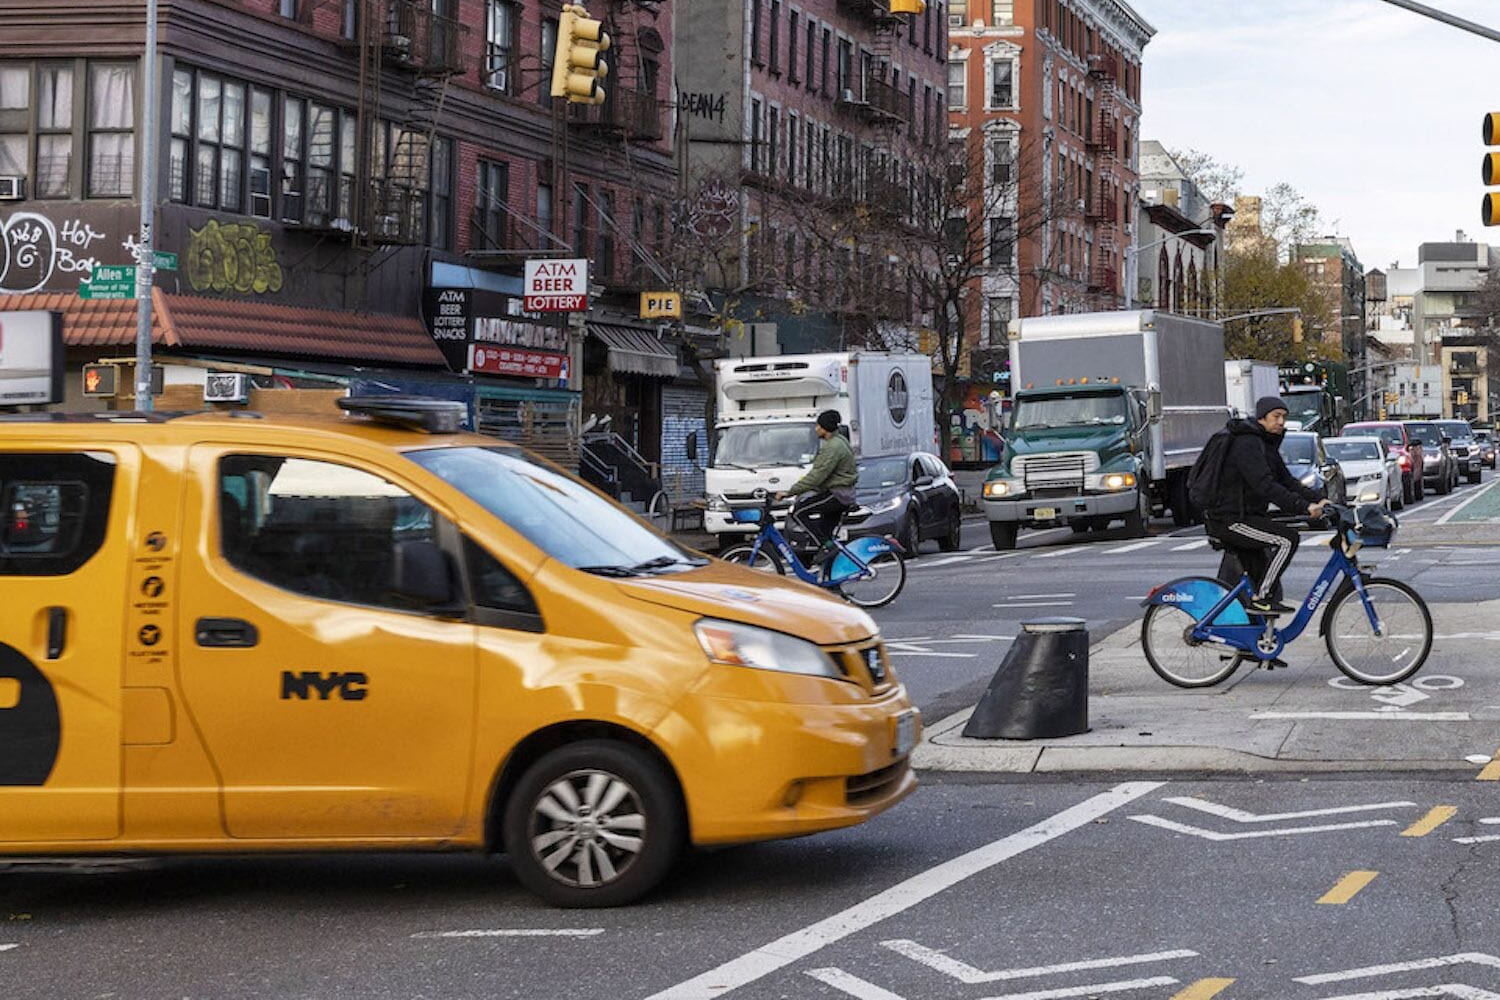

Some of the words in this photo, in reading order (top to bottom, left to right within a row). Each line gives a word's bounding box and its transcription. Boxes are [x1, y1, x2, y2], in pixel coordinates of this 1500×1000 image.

[96, 268, 122, 280] Allen
[534, 263, 577, 276] ATM
[532, 279, 573, 291] BEER
[438, 291, 465, 302] ATM
[527, 296, 582, 309] LOTTERY
[440, 304, 462, 315] BEER
[648, 299, 673, 310] PIE
[434, 316, 466, 327] LOTTERY
[433, 328, 466, 340] SNACKS
[280, 671, 369, 701] NYC
